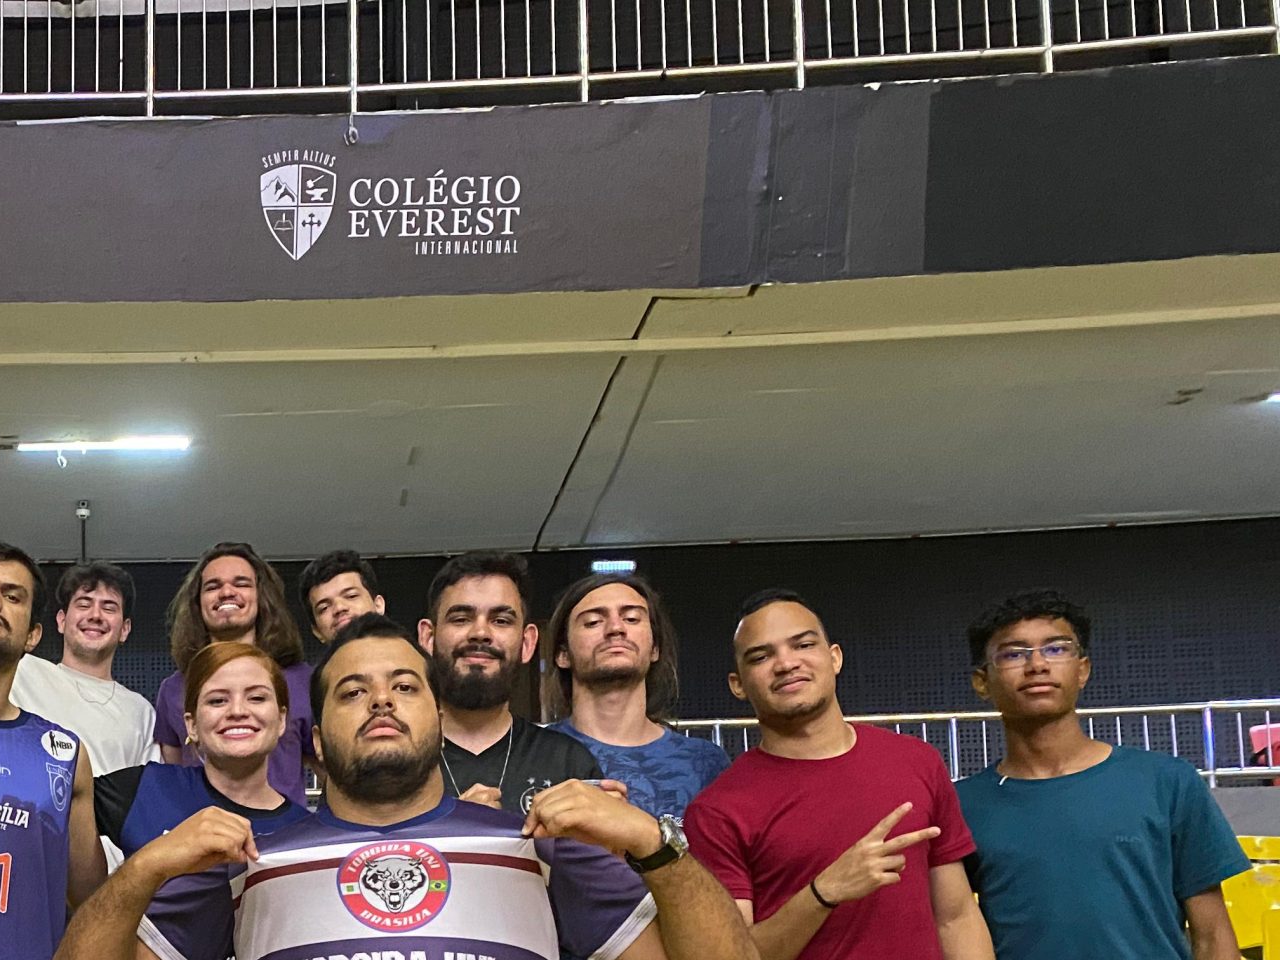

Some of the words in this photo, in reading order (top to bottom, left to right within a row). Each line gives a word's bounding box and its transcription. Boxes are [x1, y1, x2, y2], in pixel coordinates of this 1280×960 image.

[302, 149, 337, 168] ALTIUS
[349, 169, 521, 207] COLÉGIO
[348, 207, 520, 237] EVEREST
[415, 239, 518, 256] INTERNACIONAL
[415, 848, 441, 869] UNI
